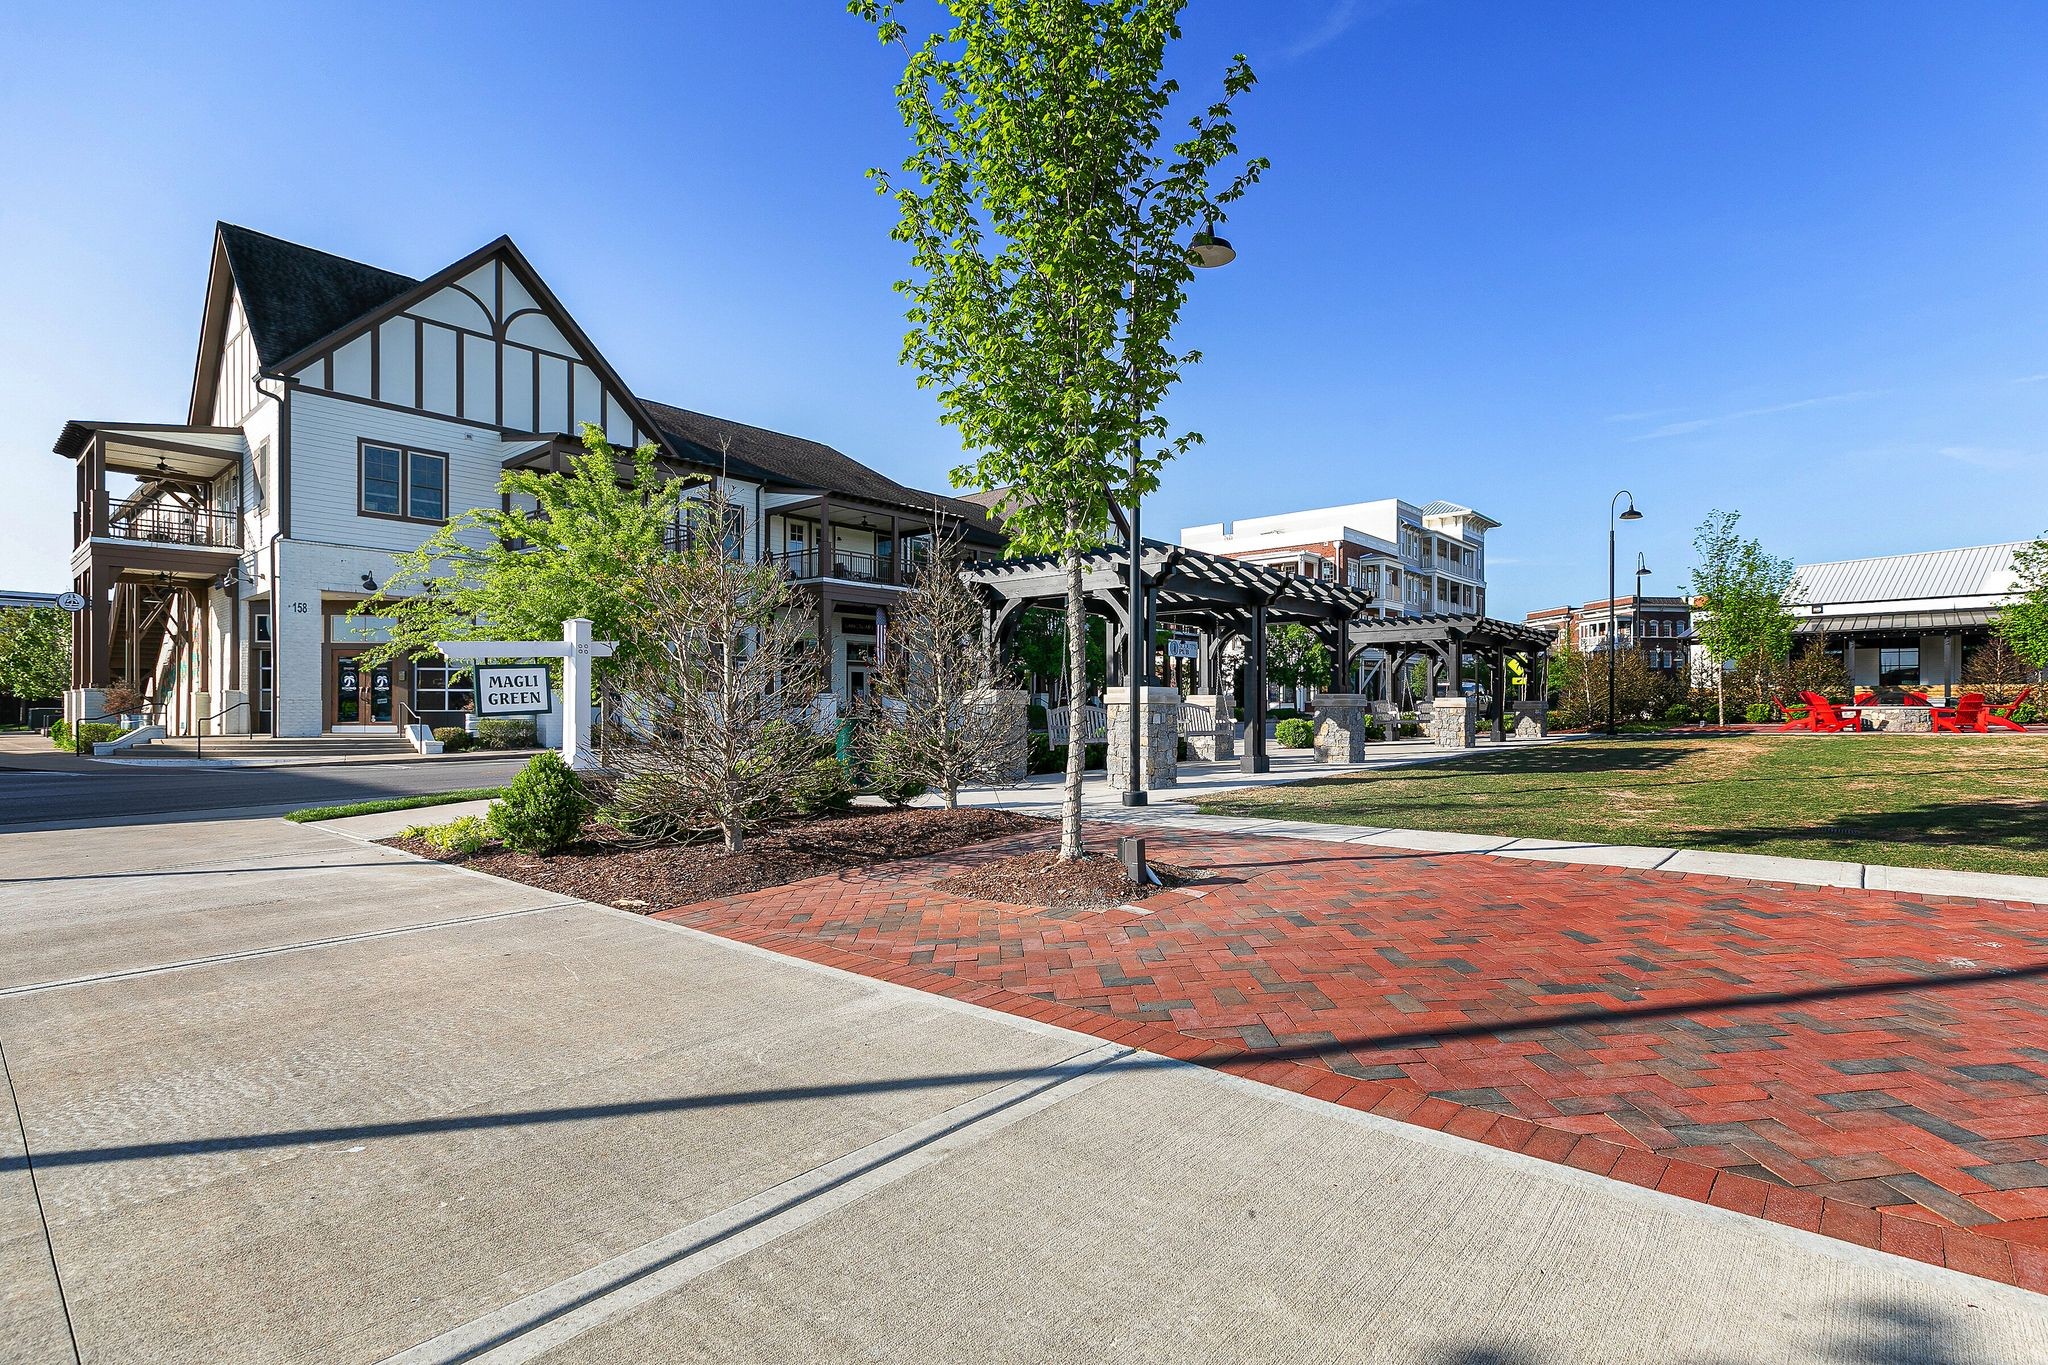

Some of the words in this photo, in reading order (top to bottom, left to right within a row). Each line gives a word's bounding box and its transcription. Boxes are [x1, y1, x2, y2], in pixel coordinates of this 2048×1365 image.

[292, 602, 308, 614] 158
[489, 675, 539, 688] MAGLI
[488, 692, 541, 705] GREEN
